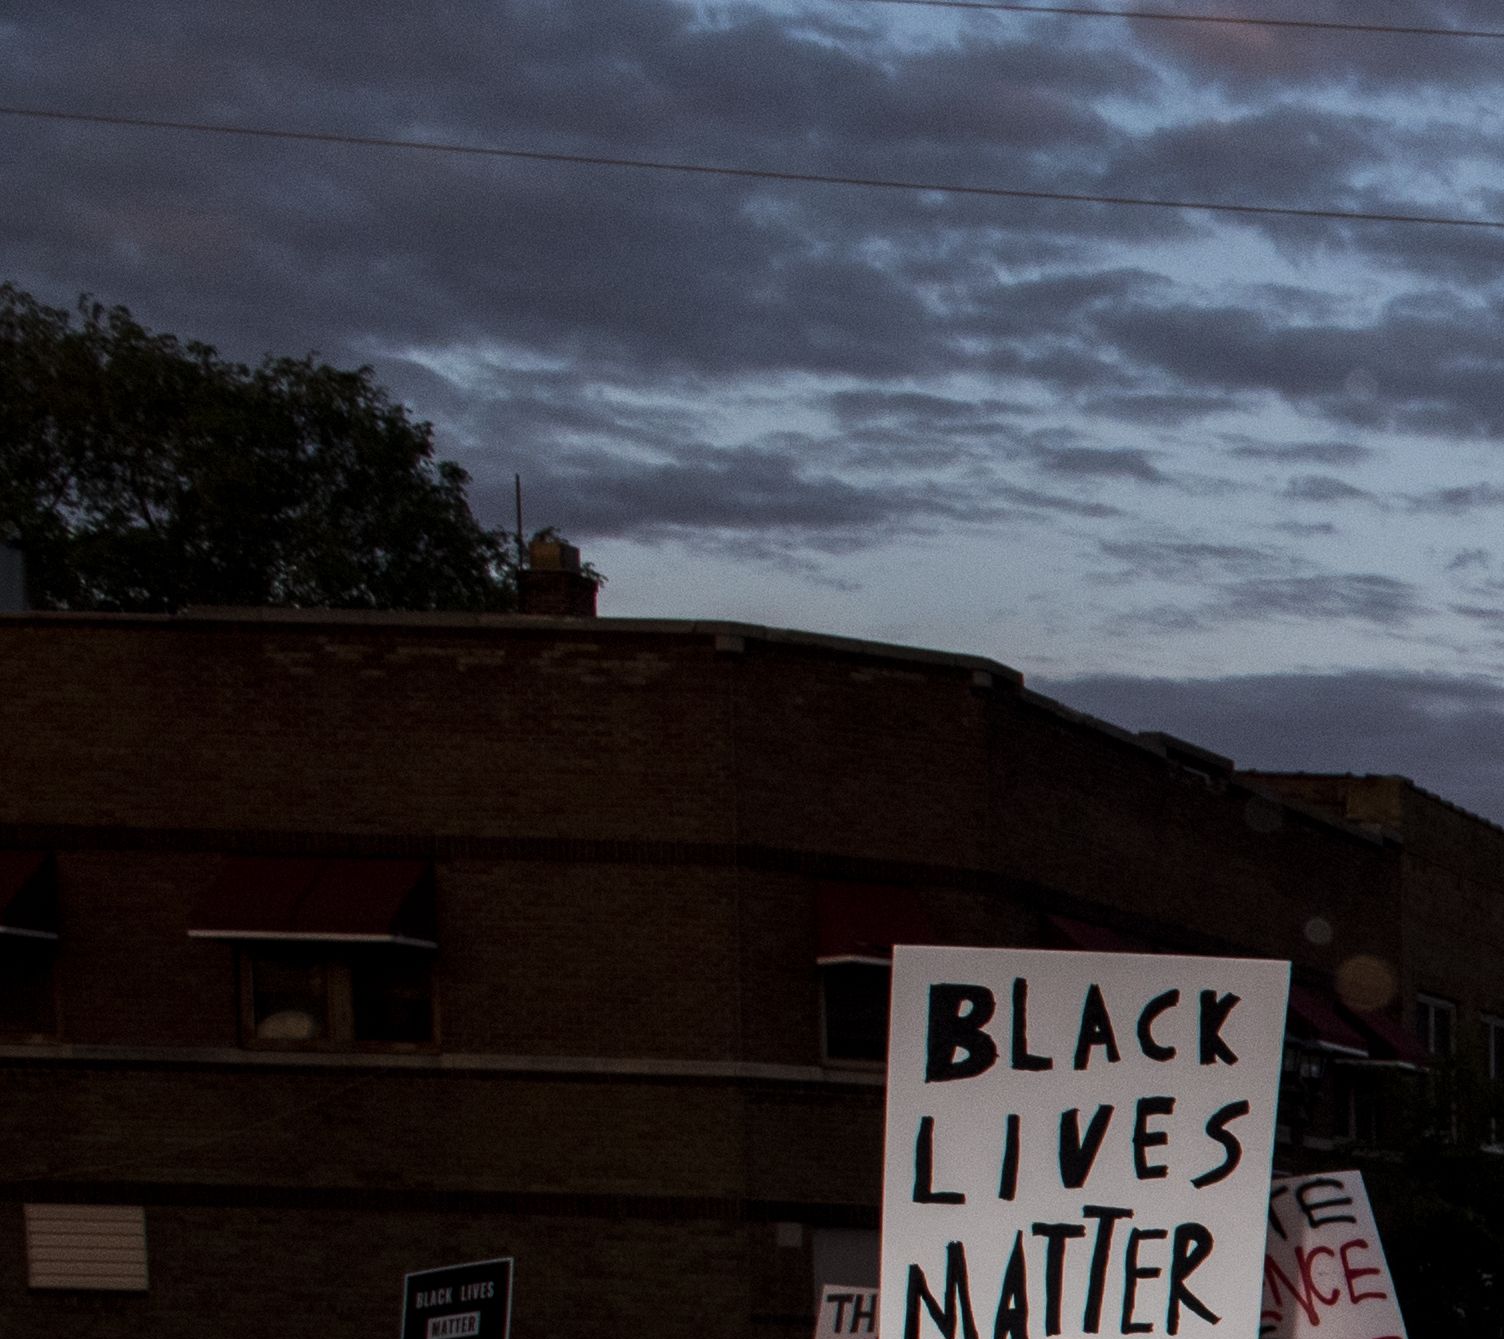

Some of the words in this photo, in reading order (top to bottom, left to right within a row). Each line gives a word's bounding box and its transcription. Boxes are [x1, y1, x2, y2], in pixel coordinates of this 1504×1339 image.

[924, 976, 1242, 1084] BLACK
[912, 1096, 1250, 1206] LIVES
[414, 1286, 453, 1310] BLACK
[460, 1281, 495, 1302] LIVES
[431, 1316, 476, 1337] MATTER
